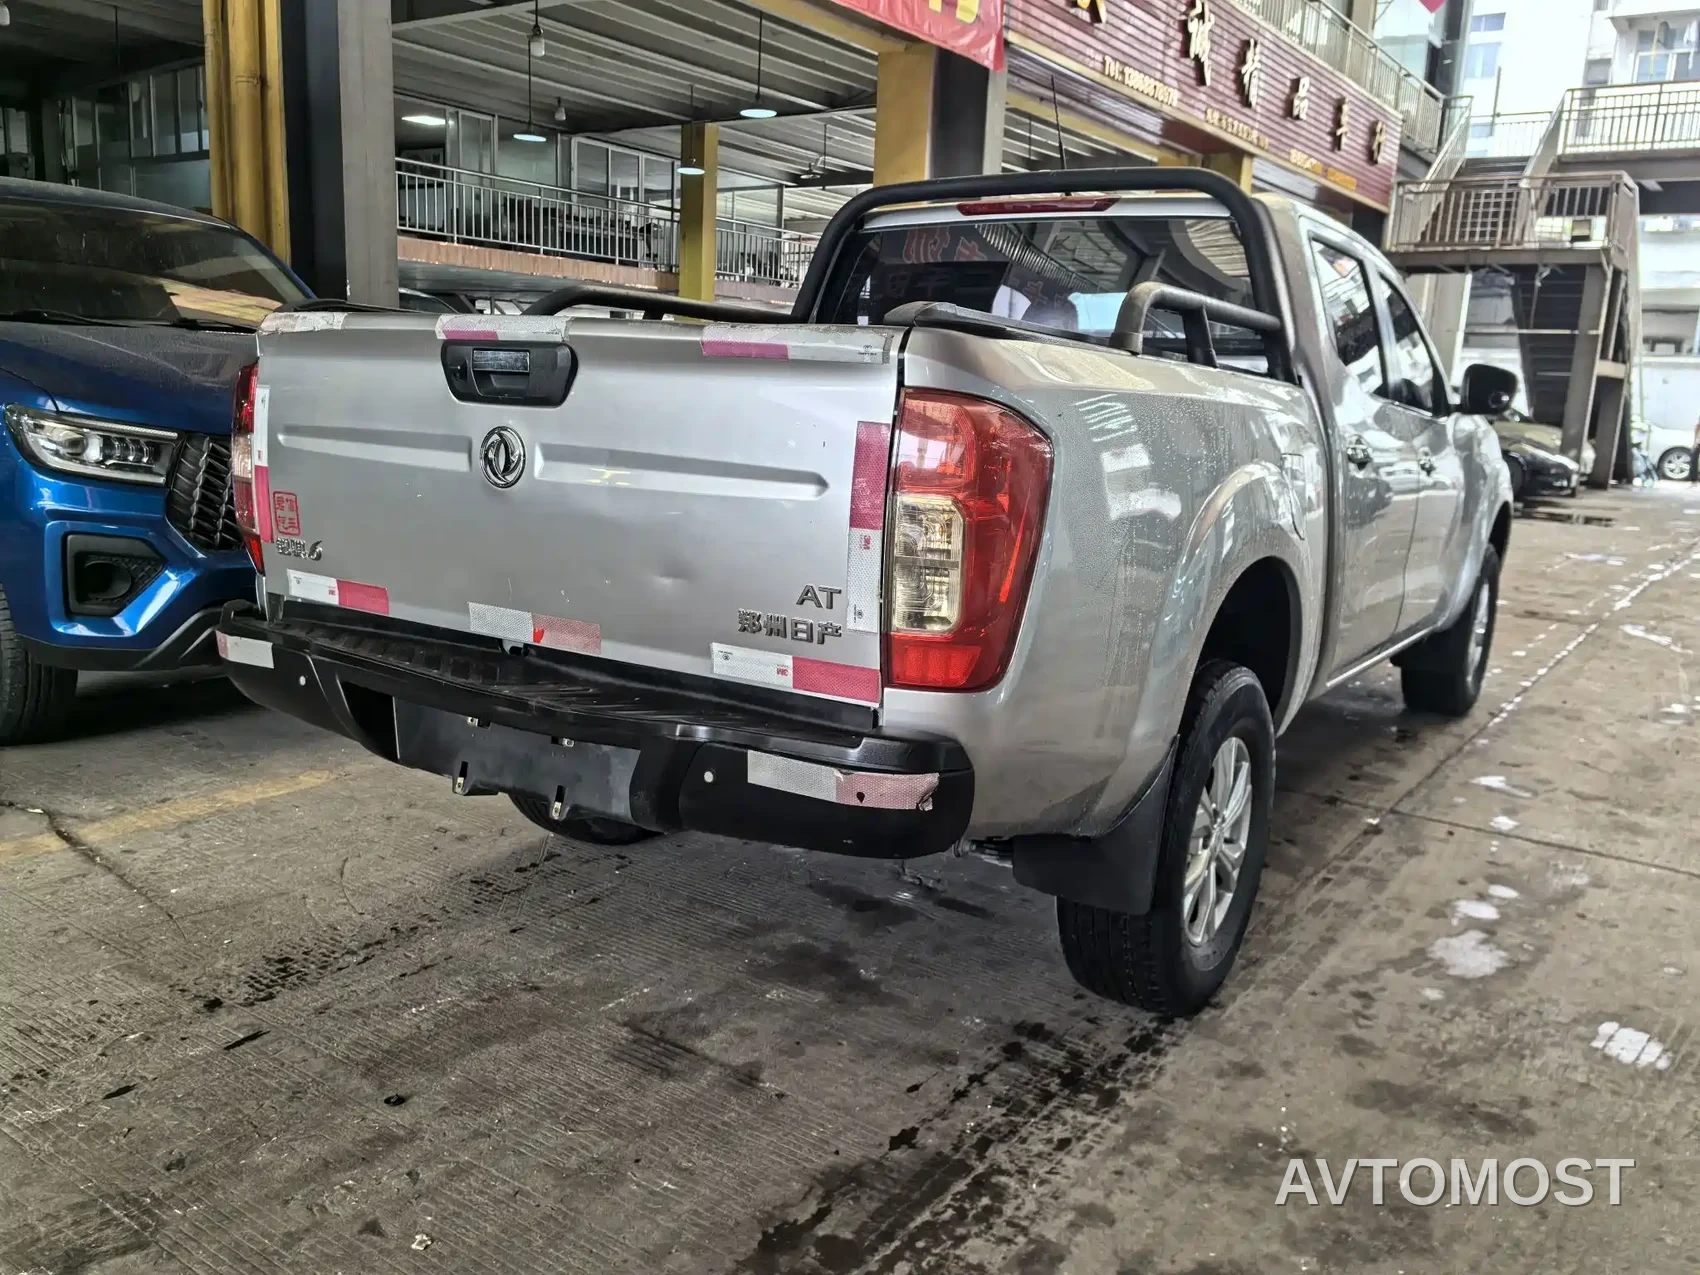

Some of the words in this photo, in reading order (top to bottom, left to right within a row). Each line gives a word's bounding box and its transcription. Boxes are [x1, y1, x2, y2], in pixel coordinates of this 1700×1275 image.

[796, 584, 842, 609] AT
[738, 608, 842, 645] 郑州日产
